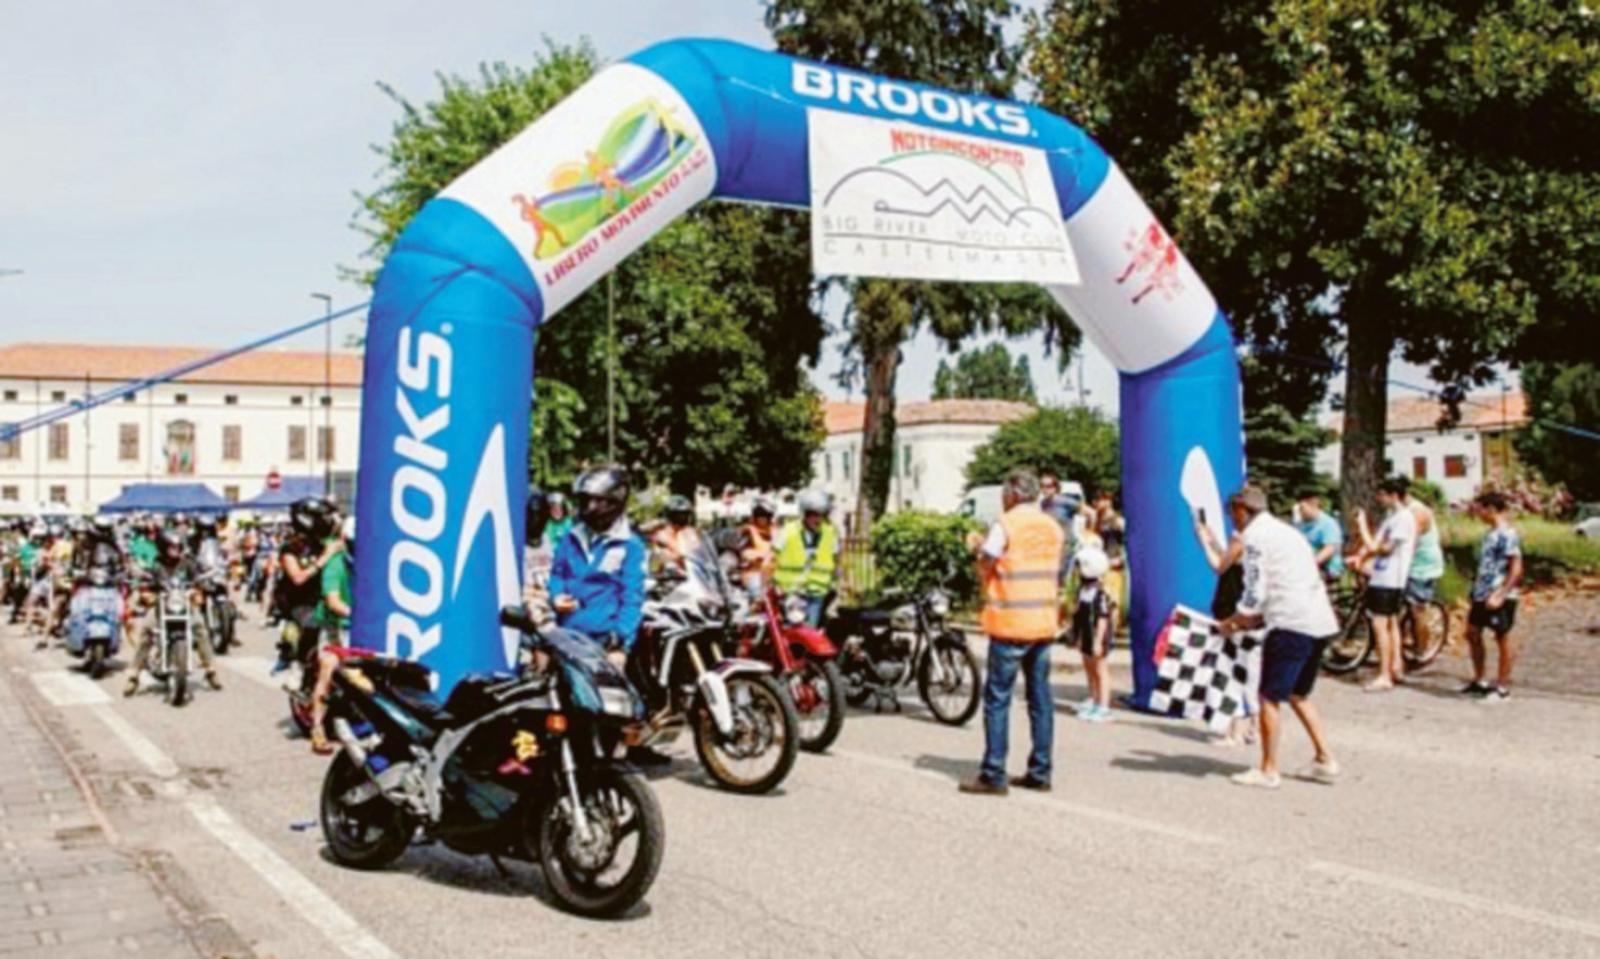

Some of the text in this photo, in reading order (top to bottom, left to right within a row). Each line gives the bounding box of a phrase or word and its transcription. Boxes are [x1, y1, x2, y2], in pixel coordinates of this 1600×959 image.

[822, 215, 858, 231] BIG
[873, 217, 926, 234] RIVER
[386, 324, 453, 691] ROOKS
